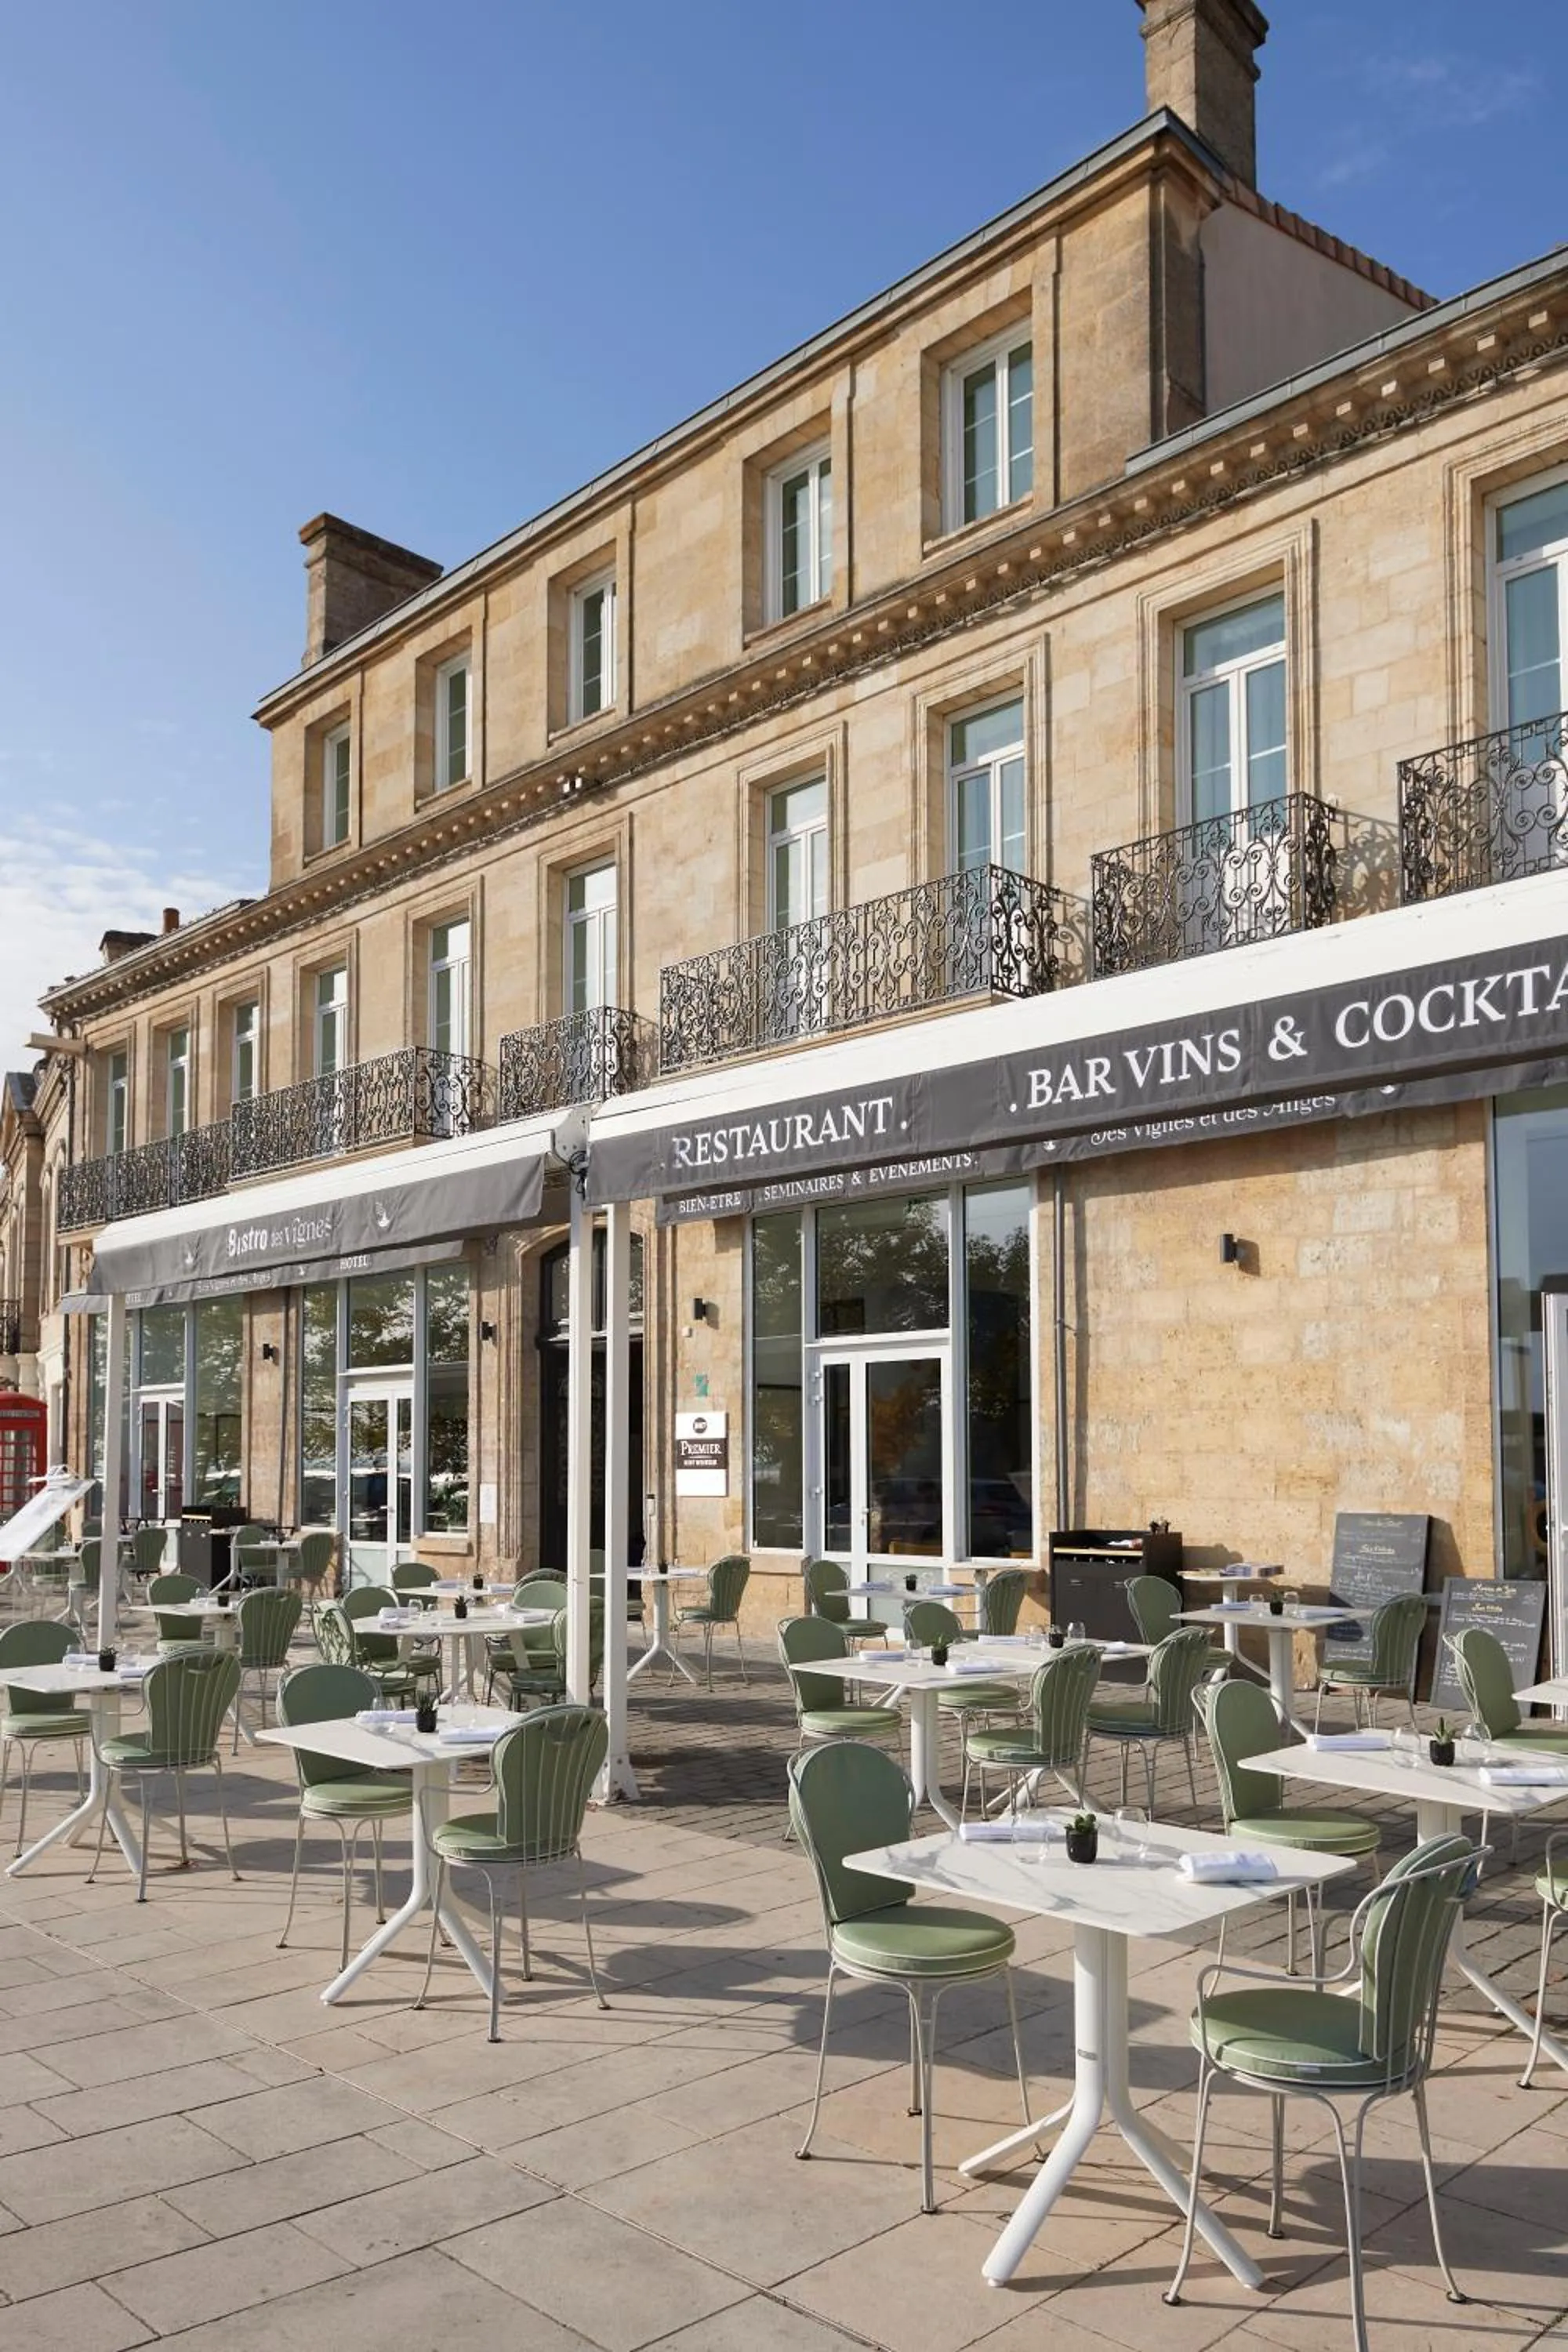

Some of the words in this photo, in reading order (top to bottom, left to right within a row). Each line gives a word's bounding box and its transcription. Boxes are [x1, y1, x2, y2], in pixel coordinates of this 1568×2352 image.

[1027, 1057, 1116, 1109] BAR
[1124, 1029, 1242, 1088] VINS
[1268, 1015, 1308, 1061] &
[851, 1171, 862, 1185] &
[229, 1225, 268, 1257] Bistro
